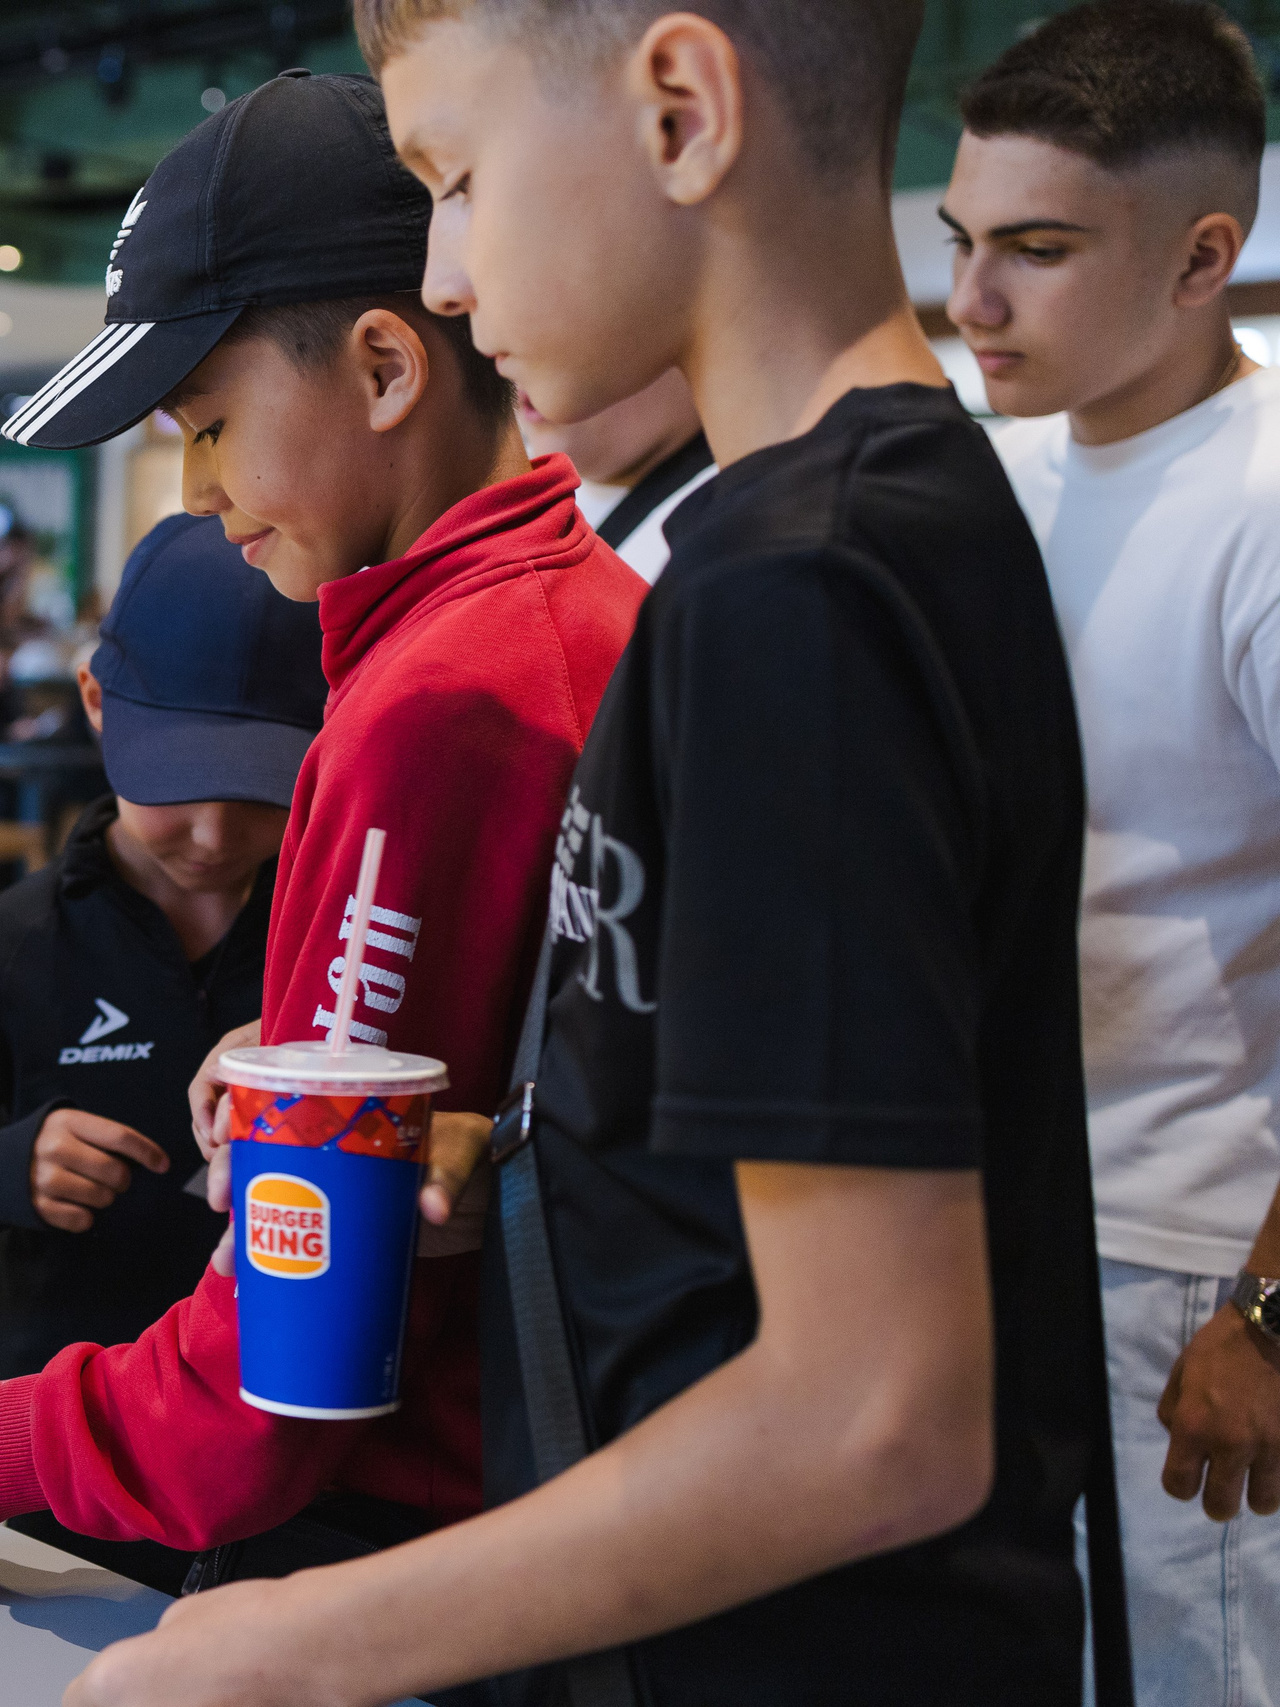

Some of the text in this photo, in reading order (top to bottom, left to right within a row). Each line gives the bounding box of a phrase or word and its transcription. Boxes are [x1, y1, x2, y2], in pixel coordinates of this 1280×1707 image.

[58, 1041, 155, 1065] DEMIX
[249, 1203, 324, 1229] BURGER
[250, 1223, 324, 1258] KING
